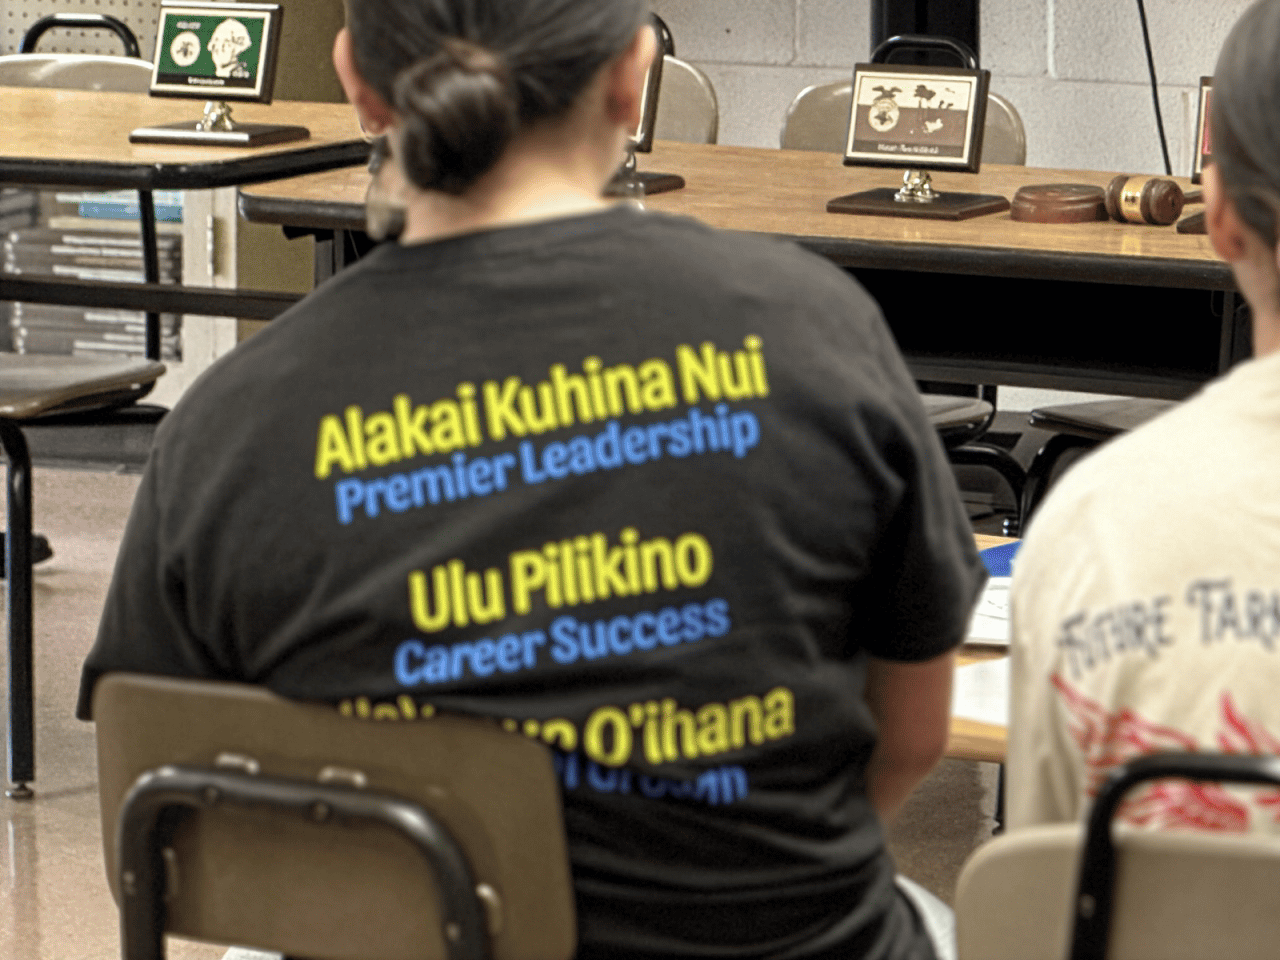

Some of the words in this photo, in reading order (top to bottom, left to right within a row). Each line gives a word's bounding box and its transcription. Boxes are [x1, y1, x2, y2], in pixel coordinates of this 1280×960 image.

[315, 383, 486, 478] Alakai
[484, 354, 677, 439] Kuhina
[674, 335, 769, 404] Nui
[334, 450, 518, 526] Premier
[517, 402, 761, 486] Leadership
[394, 629, 547, 687] Career
[549, 599, 730, 664] Success
[410, 561, 506, 631] Ulu
